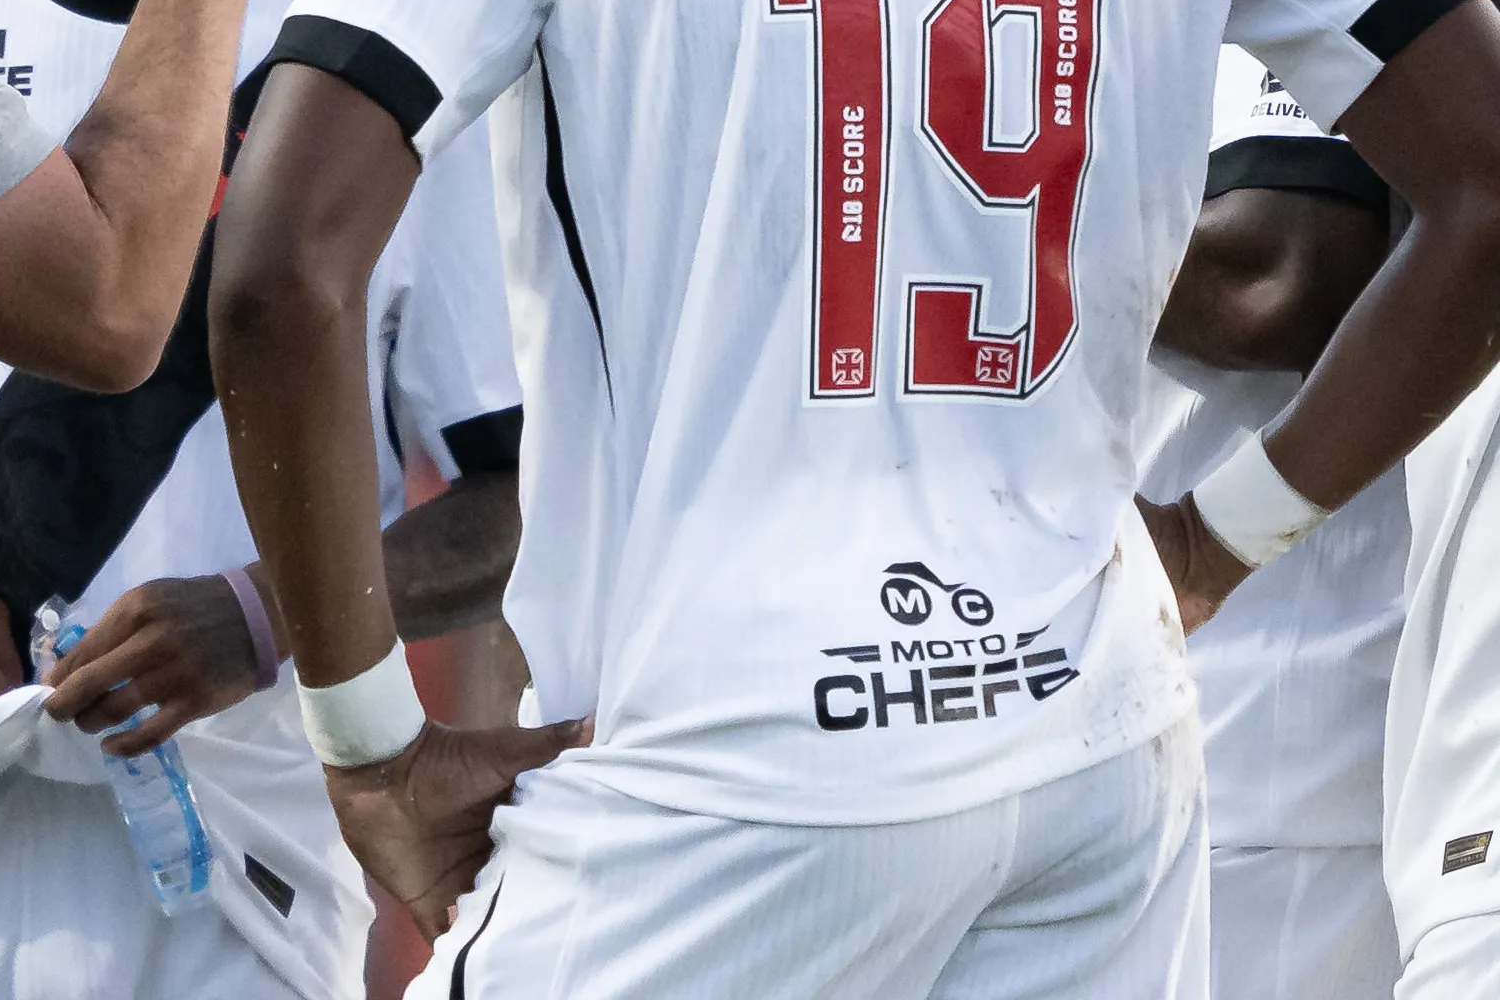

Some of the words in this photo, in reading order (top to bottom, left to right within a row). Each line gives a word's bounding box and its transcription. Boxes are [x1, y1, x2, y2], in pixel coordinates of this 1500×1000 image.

[1250, 102, 1308, 119] DELIVE
[842, 106, 865, 193] SCORE
[891, 634, 1006, 663] MOTO
